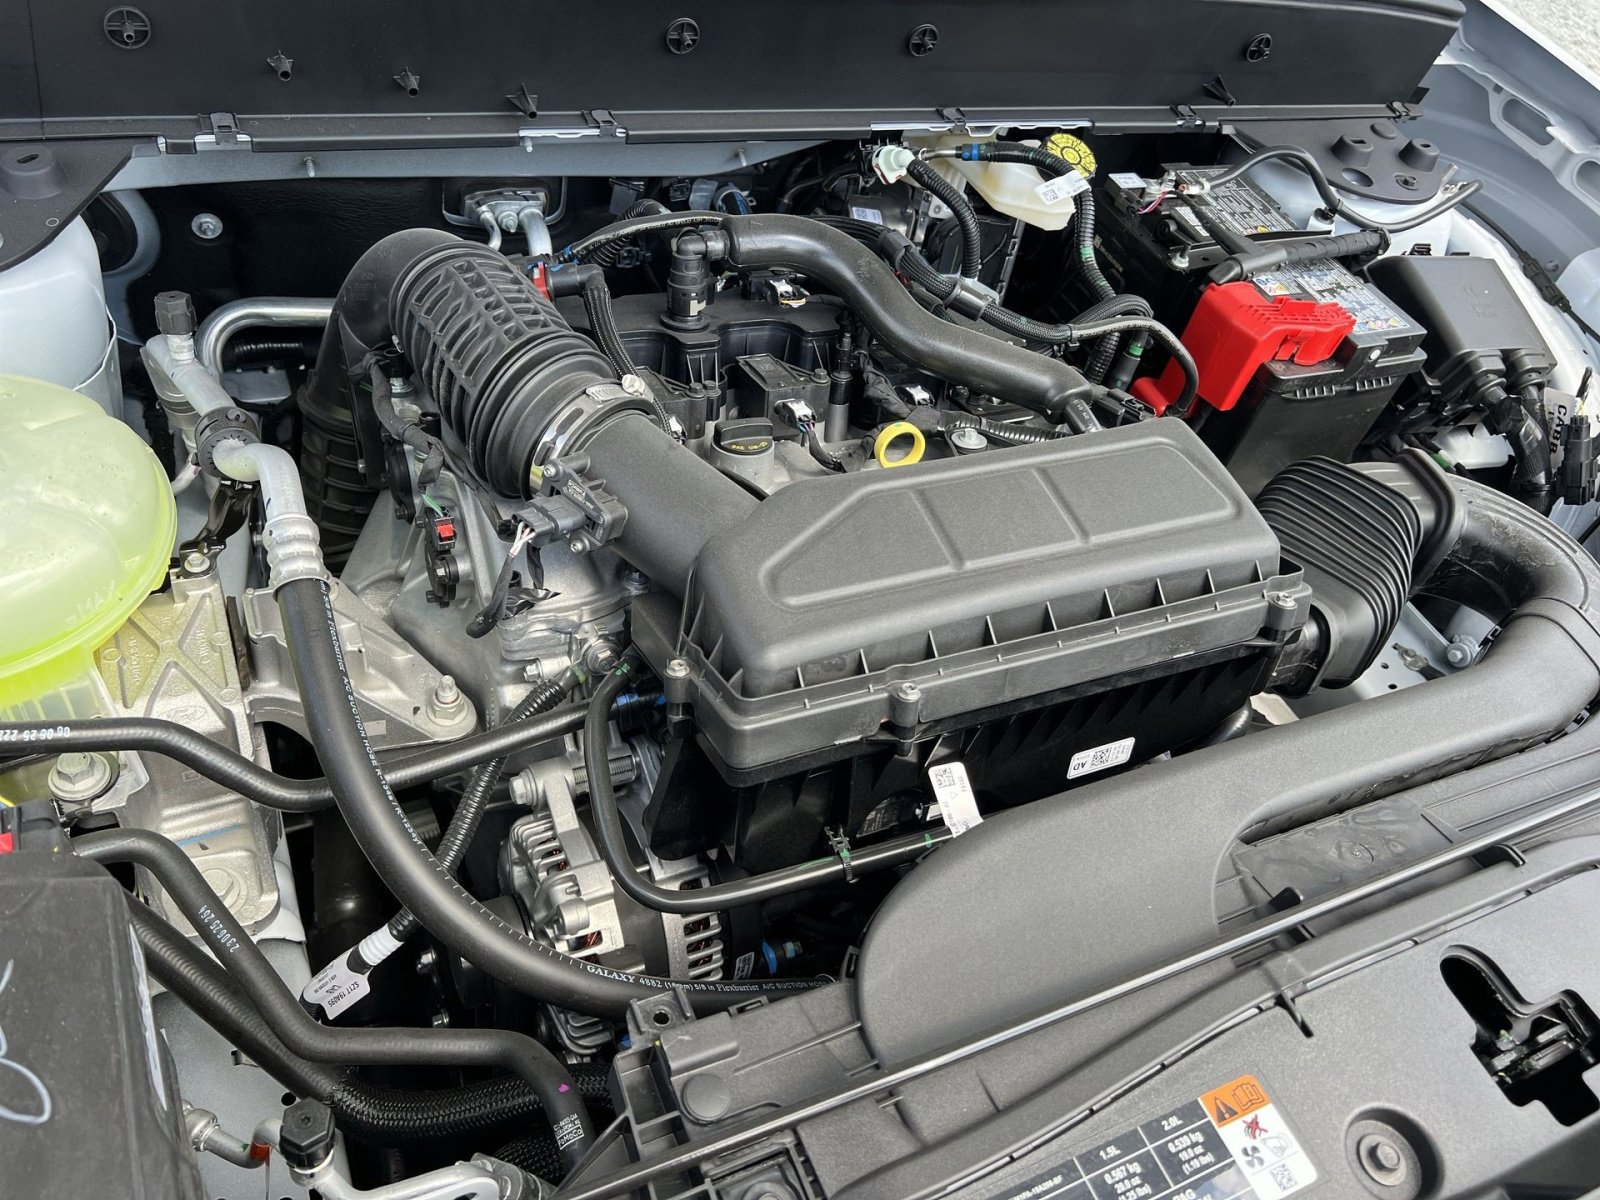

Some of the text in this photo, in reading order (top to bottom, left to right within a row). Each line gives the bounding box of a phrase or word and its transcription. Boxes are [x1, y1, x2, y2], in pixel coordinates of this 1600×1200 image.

[328, 620, 346, 673] Flexbarrier
[347, 694, 366, 737] SUCTION
[362, 739, 379, 766] HOSE
[22, 729, 38, 741] 25
[1073, 760, 1087, 771] AD
[586, 964, 636, 983] GALAXY
[639, 977, 663, 988] 4882
[716, 984, 760, 992] Flexbarrier
[1161, 1115, 1183, 1131] 2.0L
[557, 1129, 582, 1145] FoMoCo
[1188, 1131, 1204, 1143] kg
[1099, 1144, 1122, 1160] 1.5L
[1126, 1161, 1142, 1174] kg
